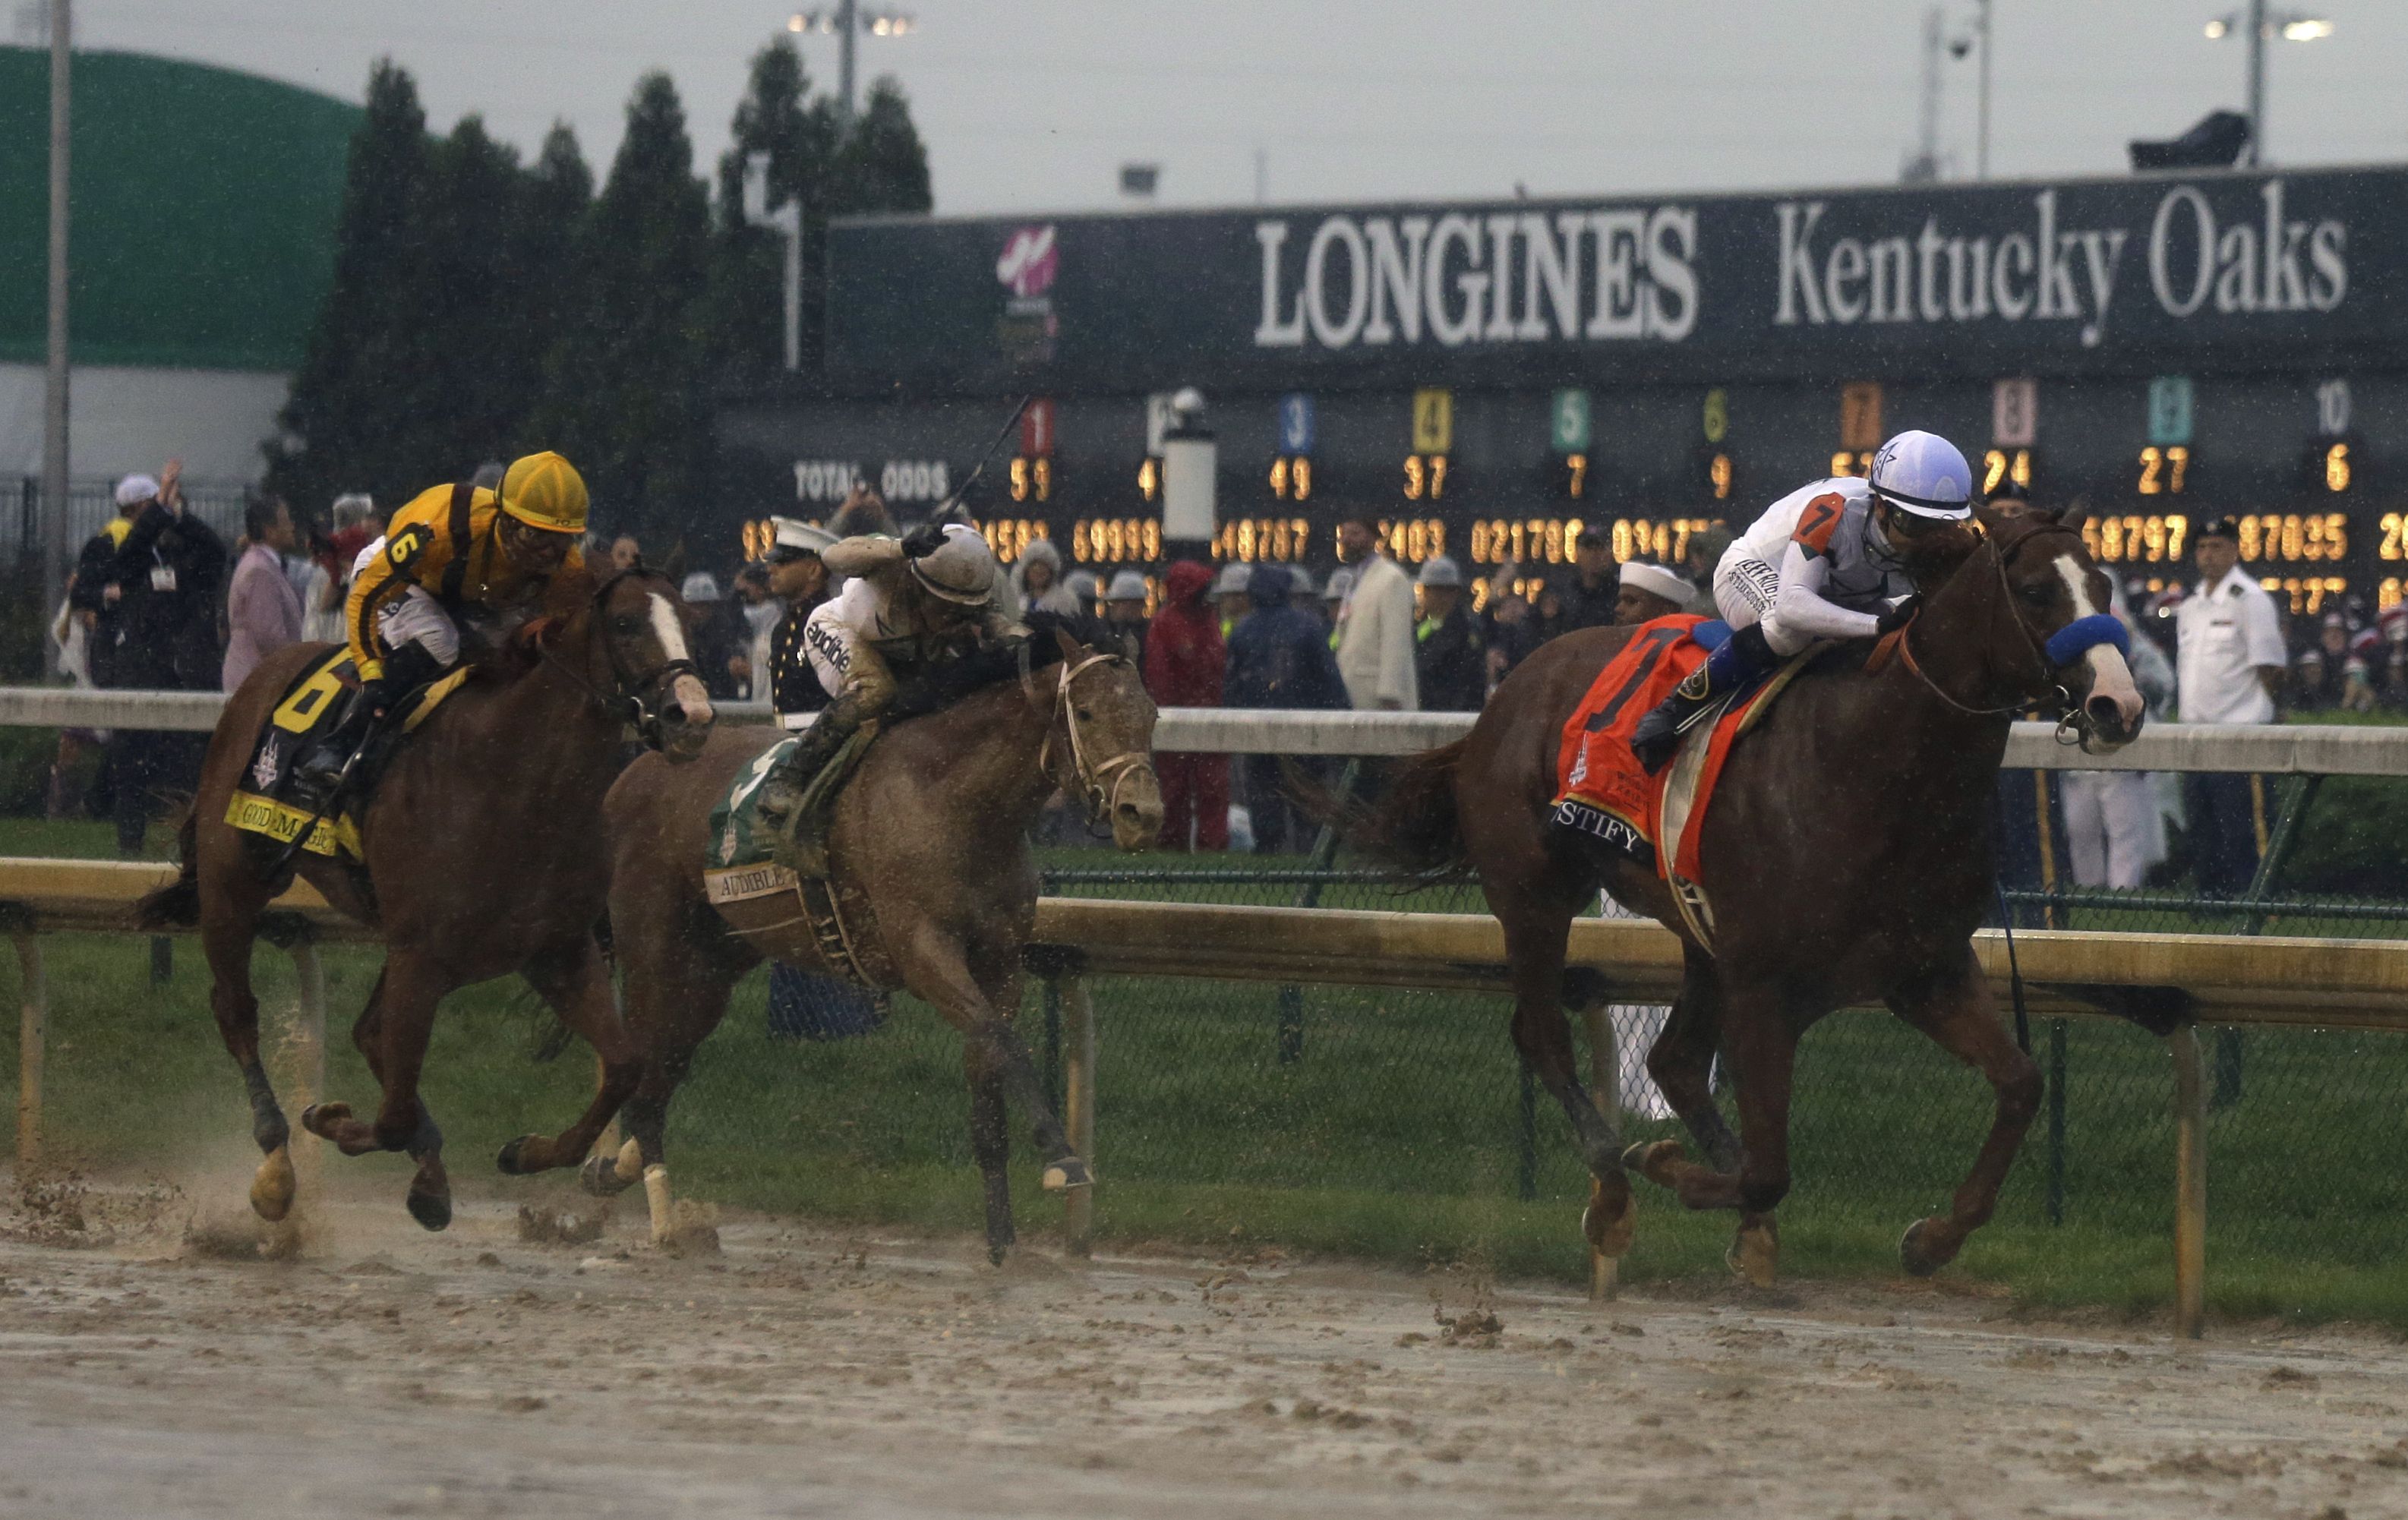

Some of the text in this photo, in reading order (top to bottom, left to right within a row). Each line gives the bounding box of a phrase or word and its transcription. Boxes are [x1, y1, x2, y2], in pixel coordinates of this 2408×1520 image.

[1254, 206, 1699, 349] LONGINES
[1772, 179, 2347, 348] Kentucky Oaks
[1704, 387, 1728, 441] 6
[881, 459, 951, 501] ODDS
[2138, 446, 2189, 495] 27
[2327, 443, 2351, 491] 6
[1801, 504, 1836, 537] 7
[390, 532, 418, 563] 6
[806, 621, 851, 673] audible
[273, 646, 356, 734] 6
[1584, 627, 1687, 733] 7
[242, 803, 272, 828] GOOD
[721, 867, 785, 897] AUDIBLE
